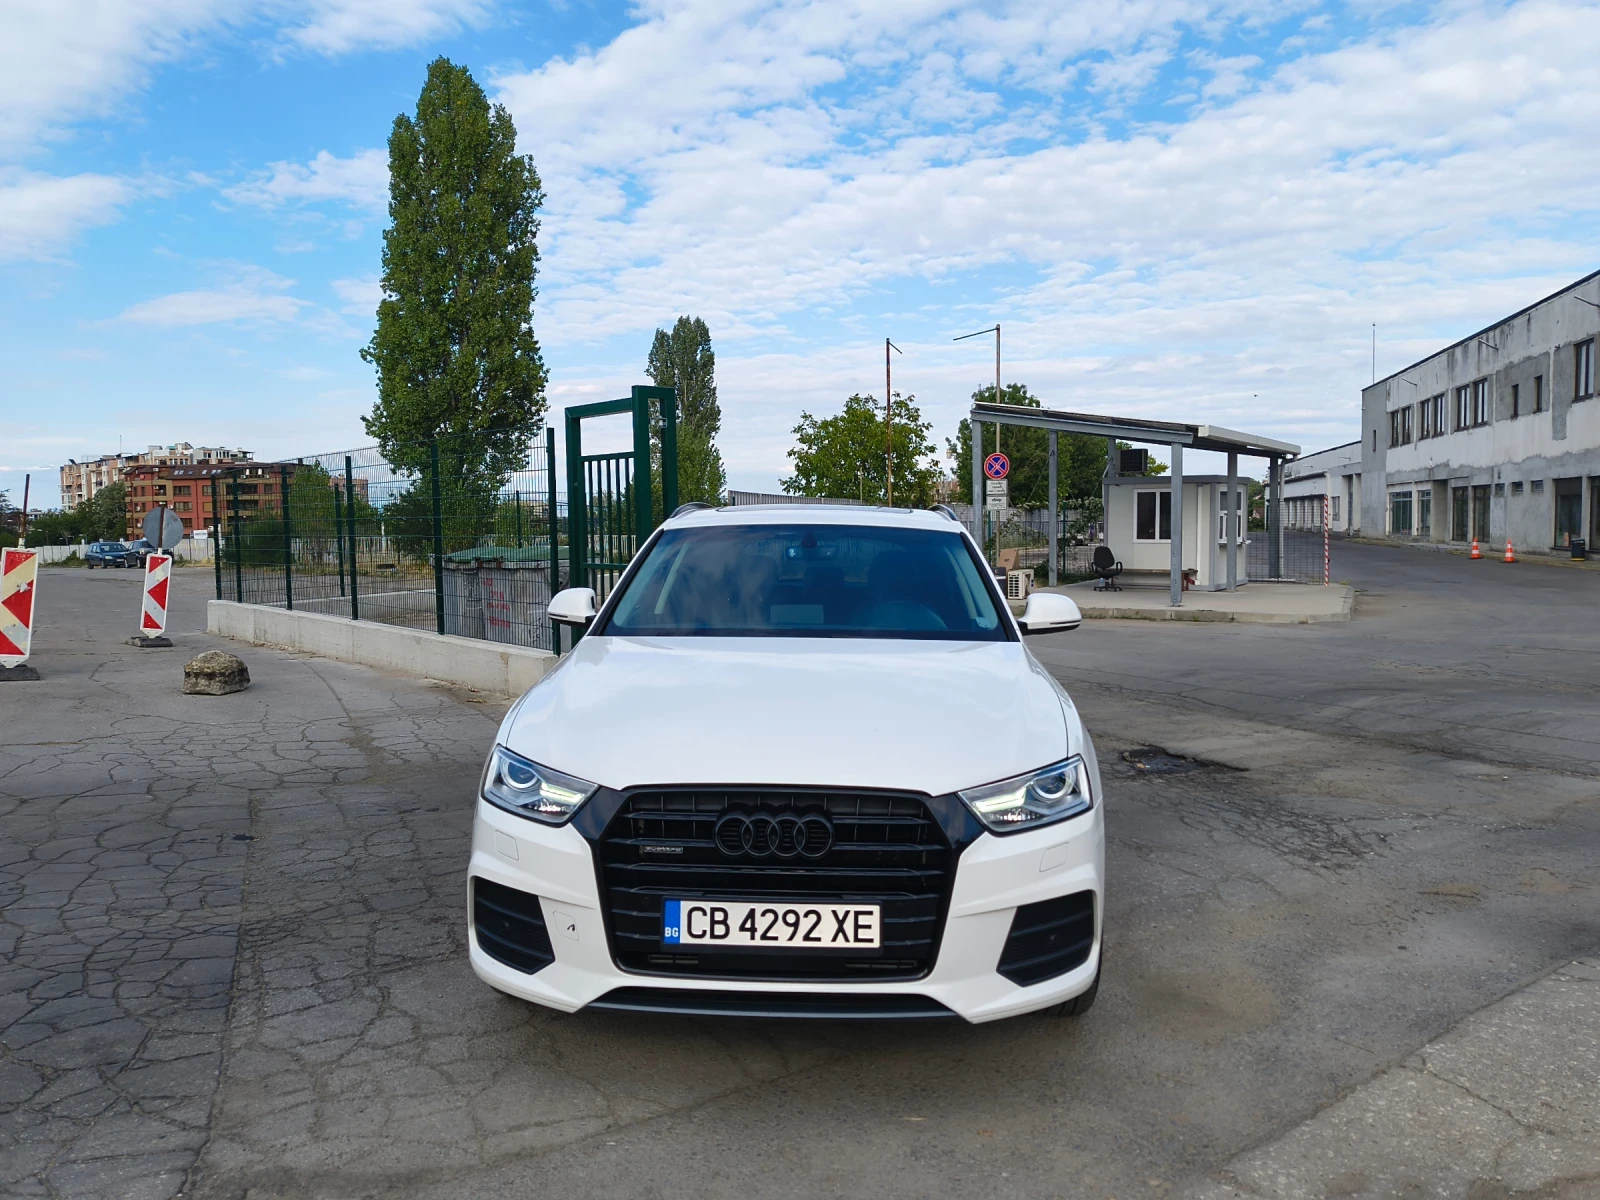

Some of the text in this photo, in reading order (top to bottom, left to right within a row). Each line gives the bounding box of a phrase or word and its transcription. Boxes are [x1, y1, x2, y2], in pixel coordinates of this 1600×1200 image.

[664, 927, 679, 937] BG
[687, 906, 875, 943] CB 4292 XE
